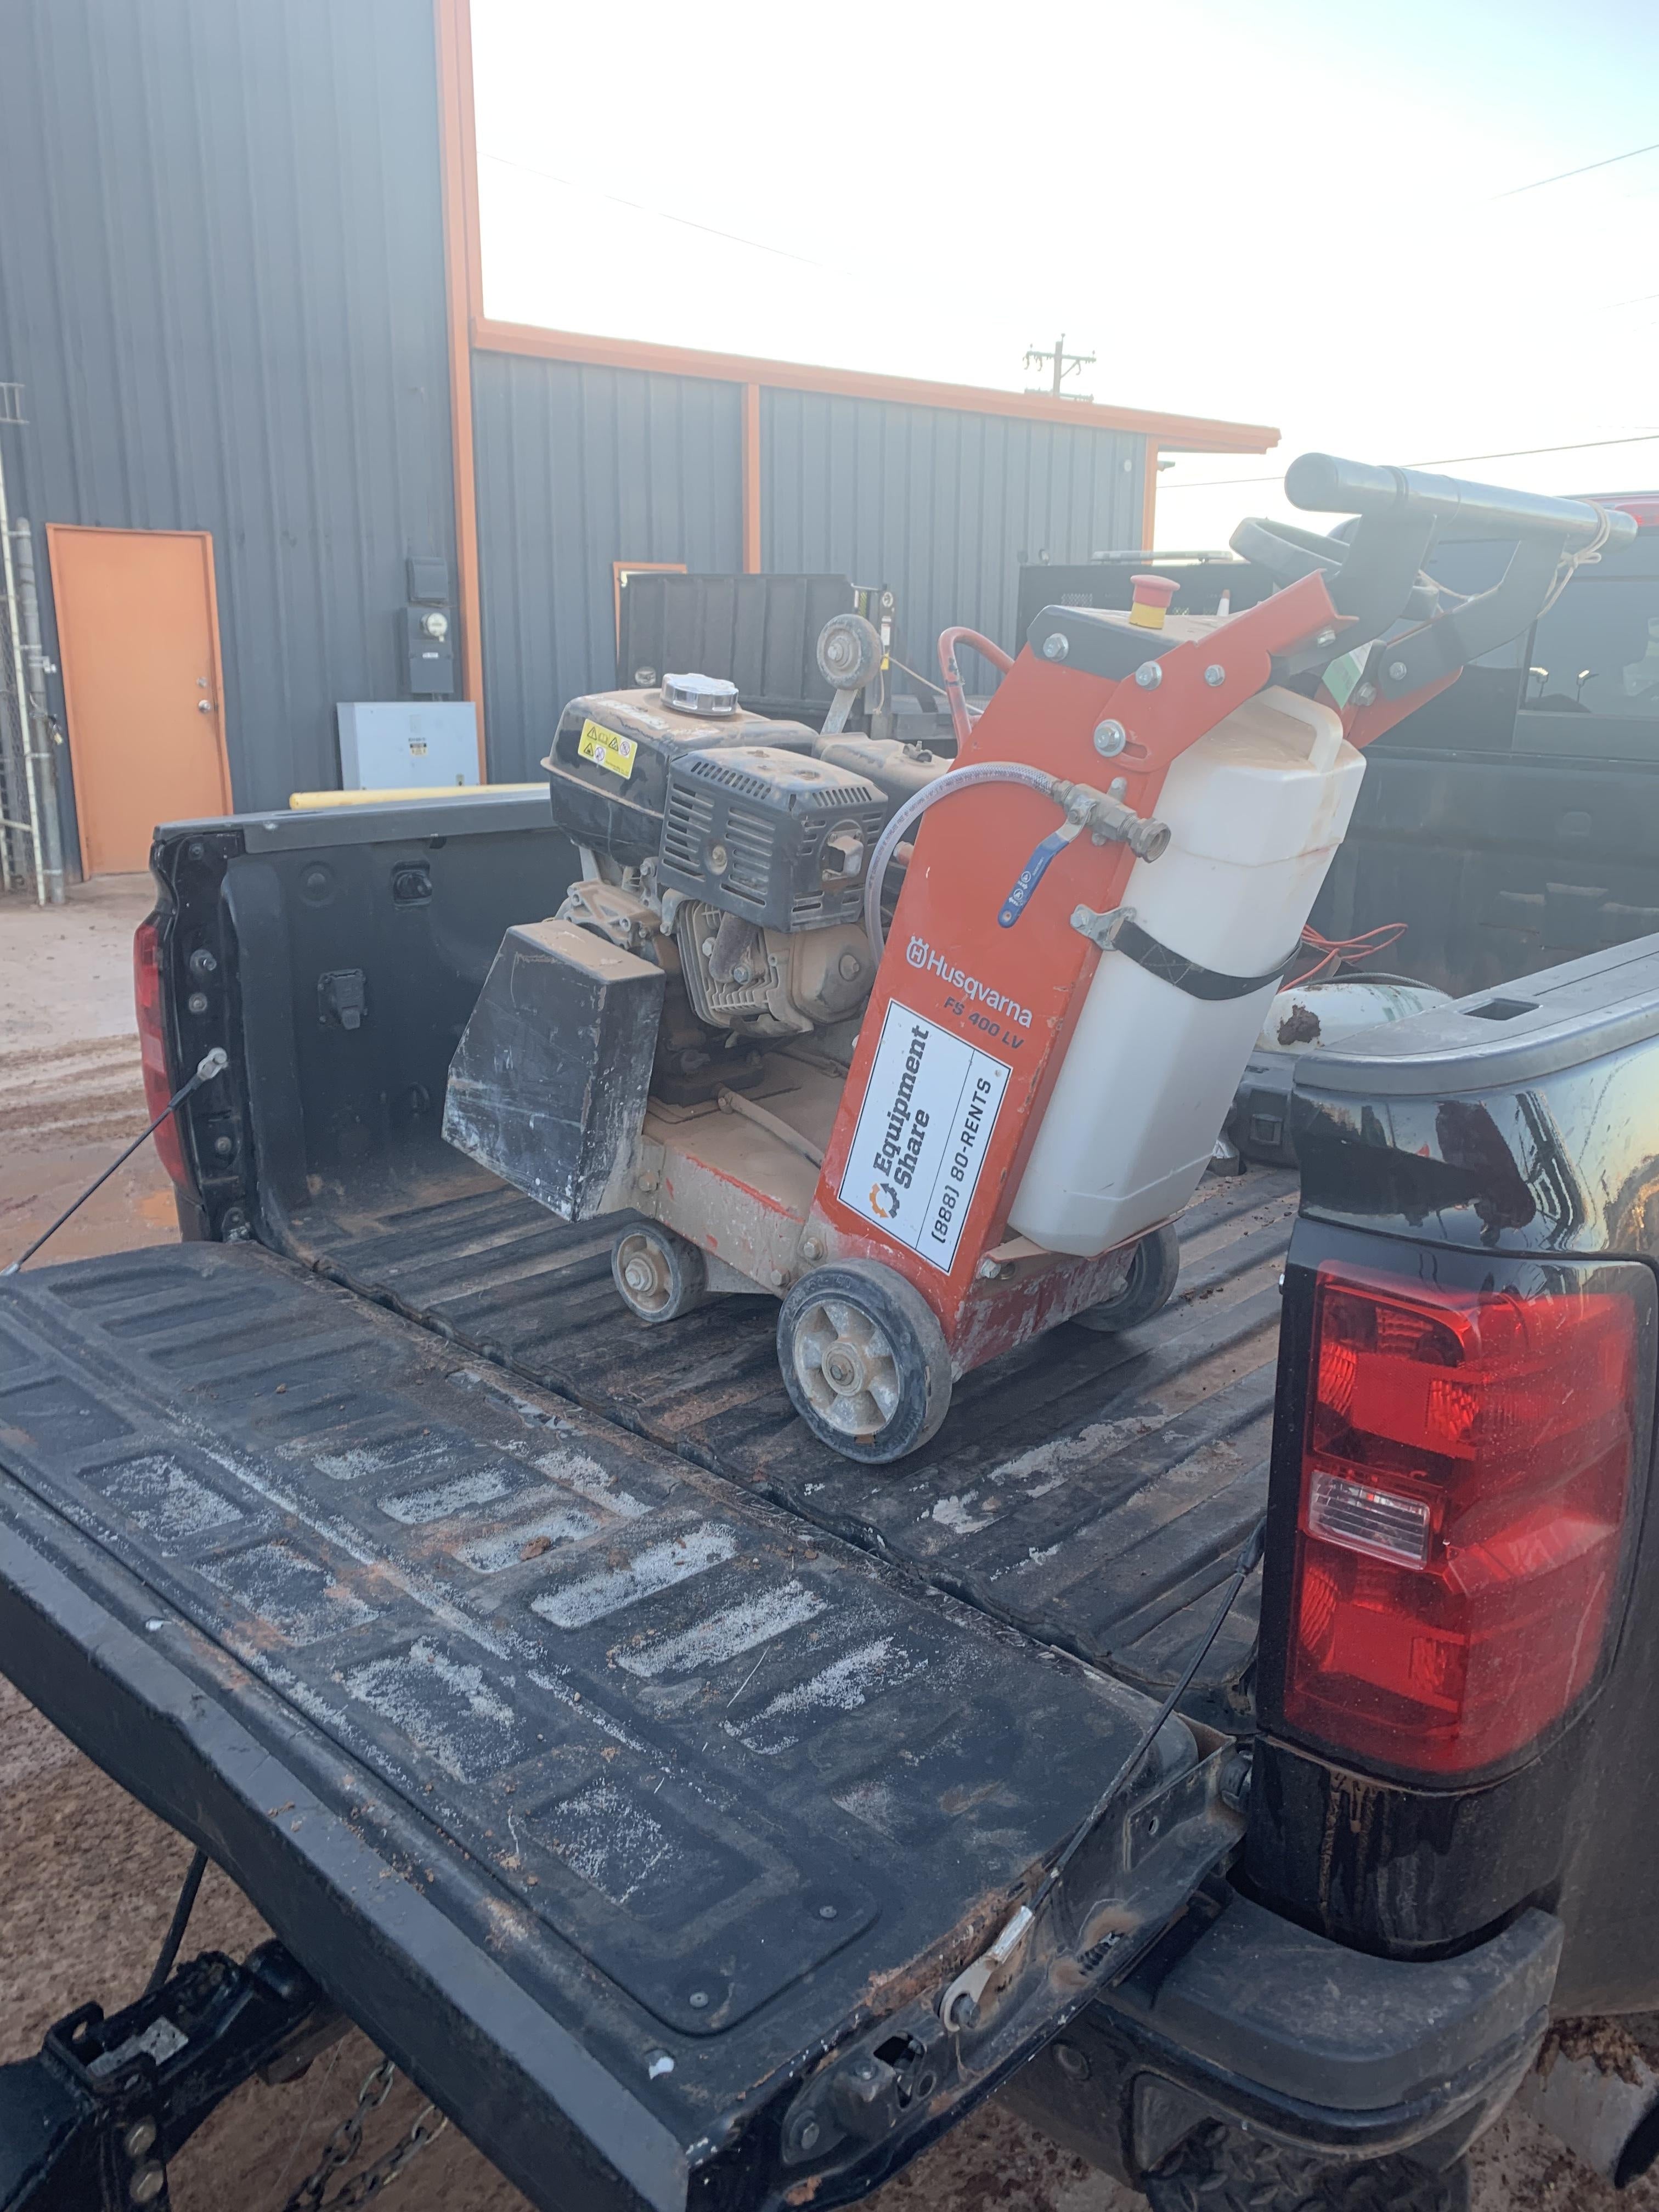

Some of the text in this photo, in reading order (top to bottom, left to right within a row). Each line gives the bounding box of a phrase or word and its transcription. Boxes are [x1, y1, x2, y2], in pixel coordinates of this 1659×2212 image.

[927, 950, 1033, 1028] Husqvarna
[944, 996, 1024, 1049] FS 400 LV
[873, 1025, 929, 1176] Equipment
[894, 1109, 929, 1189] Share
[931, 1077, 991, 1244] (888) 80-RENTS
